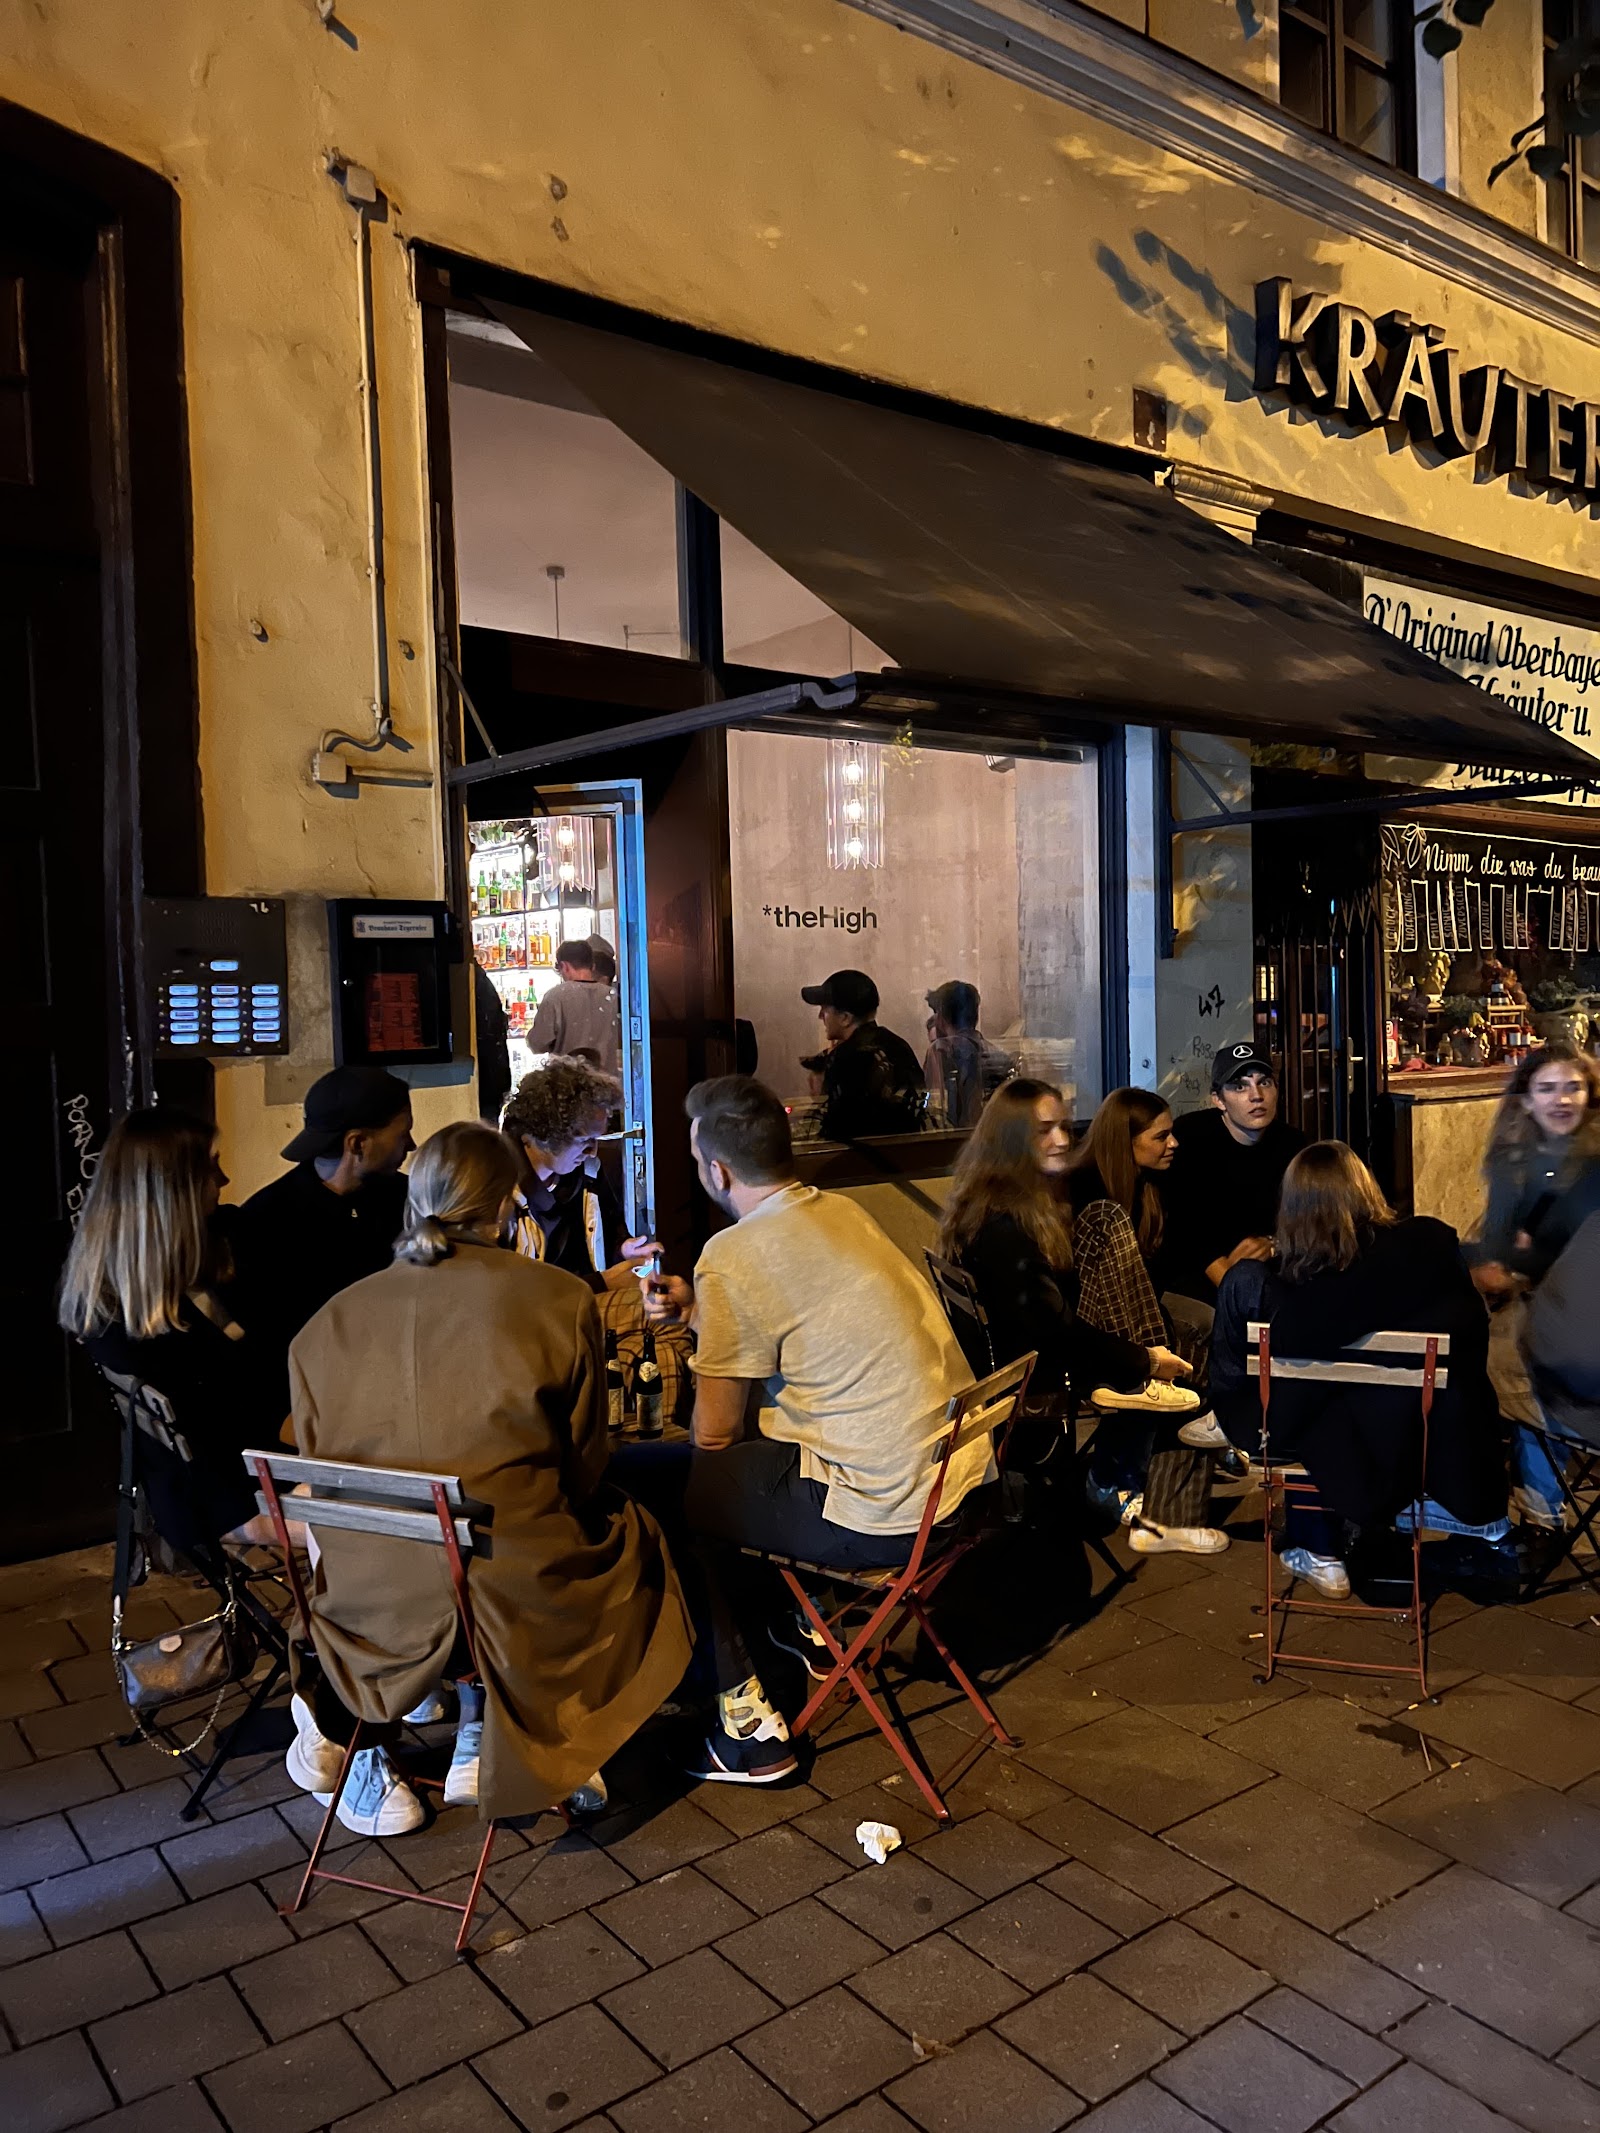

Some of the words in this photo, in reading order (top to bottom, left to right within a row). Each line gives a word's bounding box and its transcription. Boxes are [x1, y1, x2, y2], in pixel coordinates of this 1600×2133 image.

[1425, 843, 1473, 873] Nimm
[1509, 859, 1538, 877] was
[1544, 852, 1565, 879] du
[1402, 892, 1415, 940] HOFFNUNG
